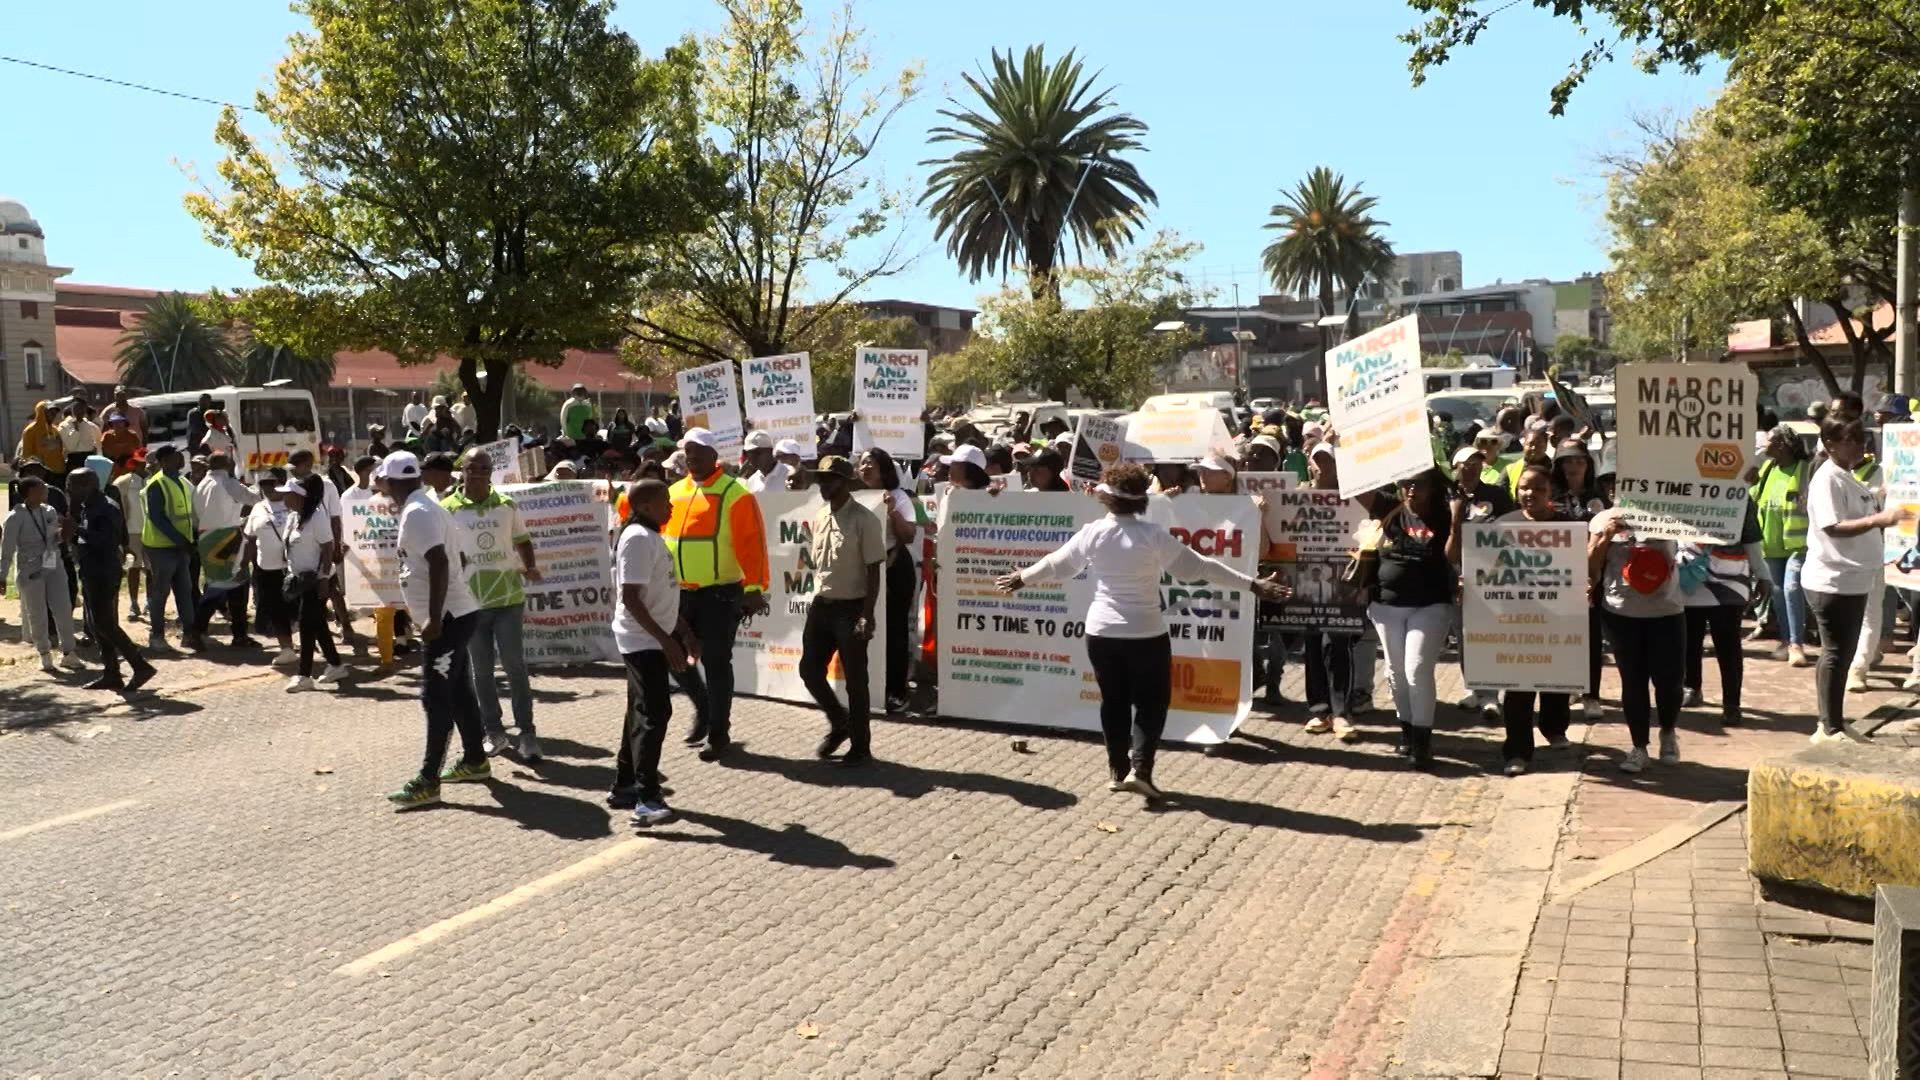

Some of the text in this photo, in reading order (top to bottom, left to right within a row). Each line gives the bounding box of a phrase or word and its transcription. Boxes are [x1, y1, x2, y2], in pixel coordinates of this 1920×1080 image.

[1336, 326, 1405, 366] MARCH
[750, 358, 801, 375] MARCH
[864, 354, 918, 366] MARCH
[1352, 352, 1392, 375] AND
[686, 366, 726, 383] MARCH
[763, 373, 792, 384] AND
[876, 366, 907, 378] AND
[697, 379, 720, 392] AND
[864, 378, 918, 391] MARCH
[1638, 377, 1744, 406] MARCH
[868, 392, 884, 400] UNTIL
[1345, 384, 1399, 412] UNTIL WE WIN
[1684, 402, 1696, 412] IN
[1639, 410, 1743, 440] MARCH
[1656, 481, 1693, 497] TIME
[1700, 484, 1720, 498] TO
[1726, 487, 1746, 500] GO
[1282, 493, 1350, 506] MARCH
[352, 504, 400, 516] MARC
[1296, 508, 1336, 520] AND
[467, 521, 499, 530] VOTE
[952, 512, 1074, 528] #DOIT4THEIRFUTURE
[1281, 520, 1350, 534] MARCH
[955, 528, 1075, 542] #DOIT4YOURCOUNT
[1476, 530, 1572, 548] MARCH
[1170, 527, 1242, 558] RCH
[1495, 549, 1552, 568] AND
[1476, 569, 1572, 587] MARCH
[567, 587, 598, 606] TO
[1484, 591, 1558, 600] UNTIL WE WIN
[957, 613, 1086, 638] IT'S TIME TO GO
[1270, 616, 1325, 625] AUGUST
[1170, 623, 1225, 642] WE WIN
[1466, 632, 1582, 646] IMMIGRATION IS AN
[952, 646, 980, 656] ILLEGAL
[982, 648, 1030, 660] IMMIGRATION
[1042, 652, 1048, 660] A
[1496, 653, 1553, 664] INVASION
